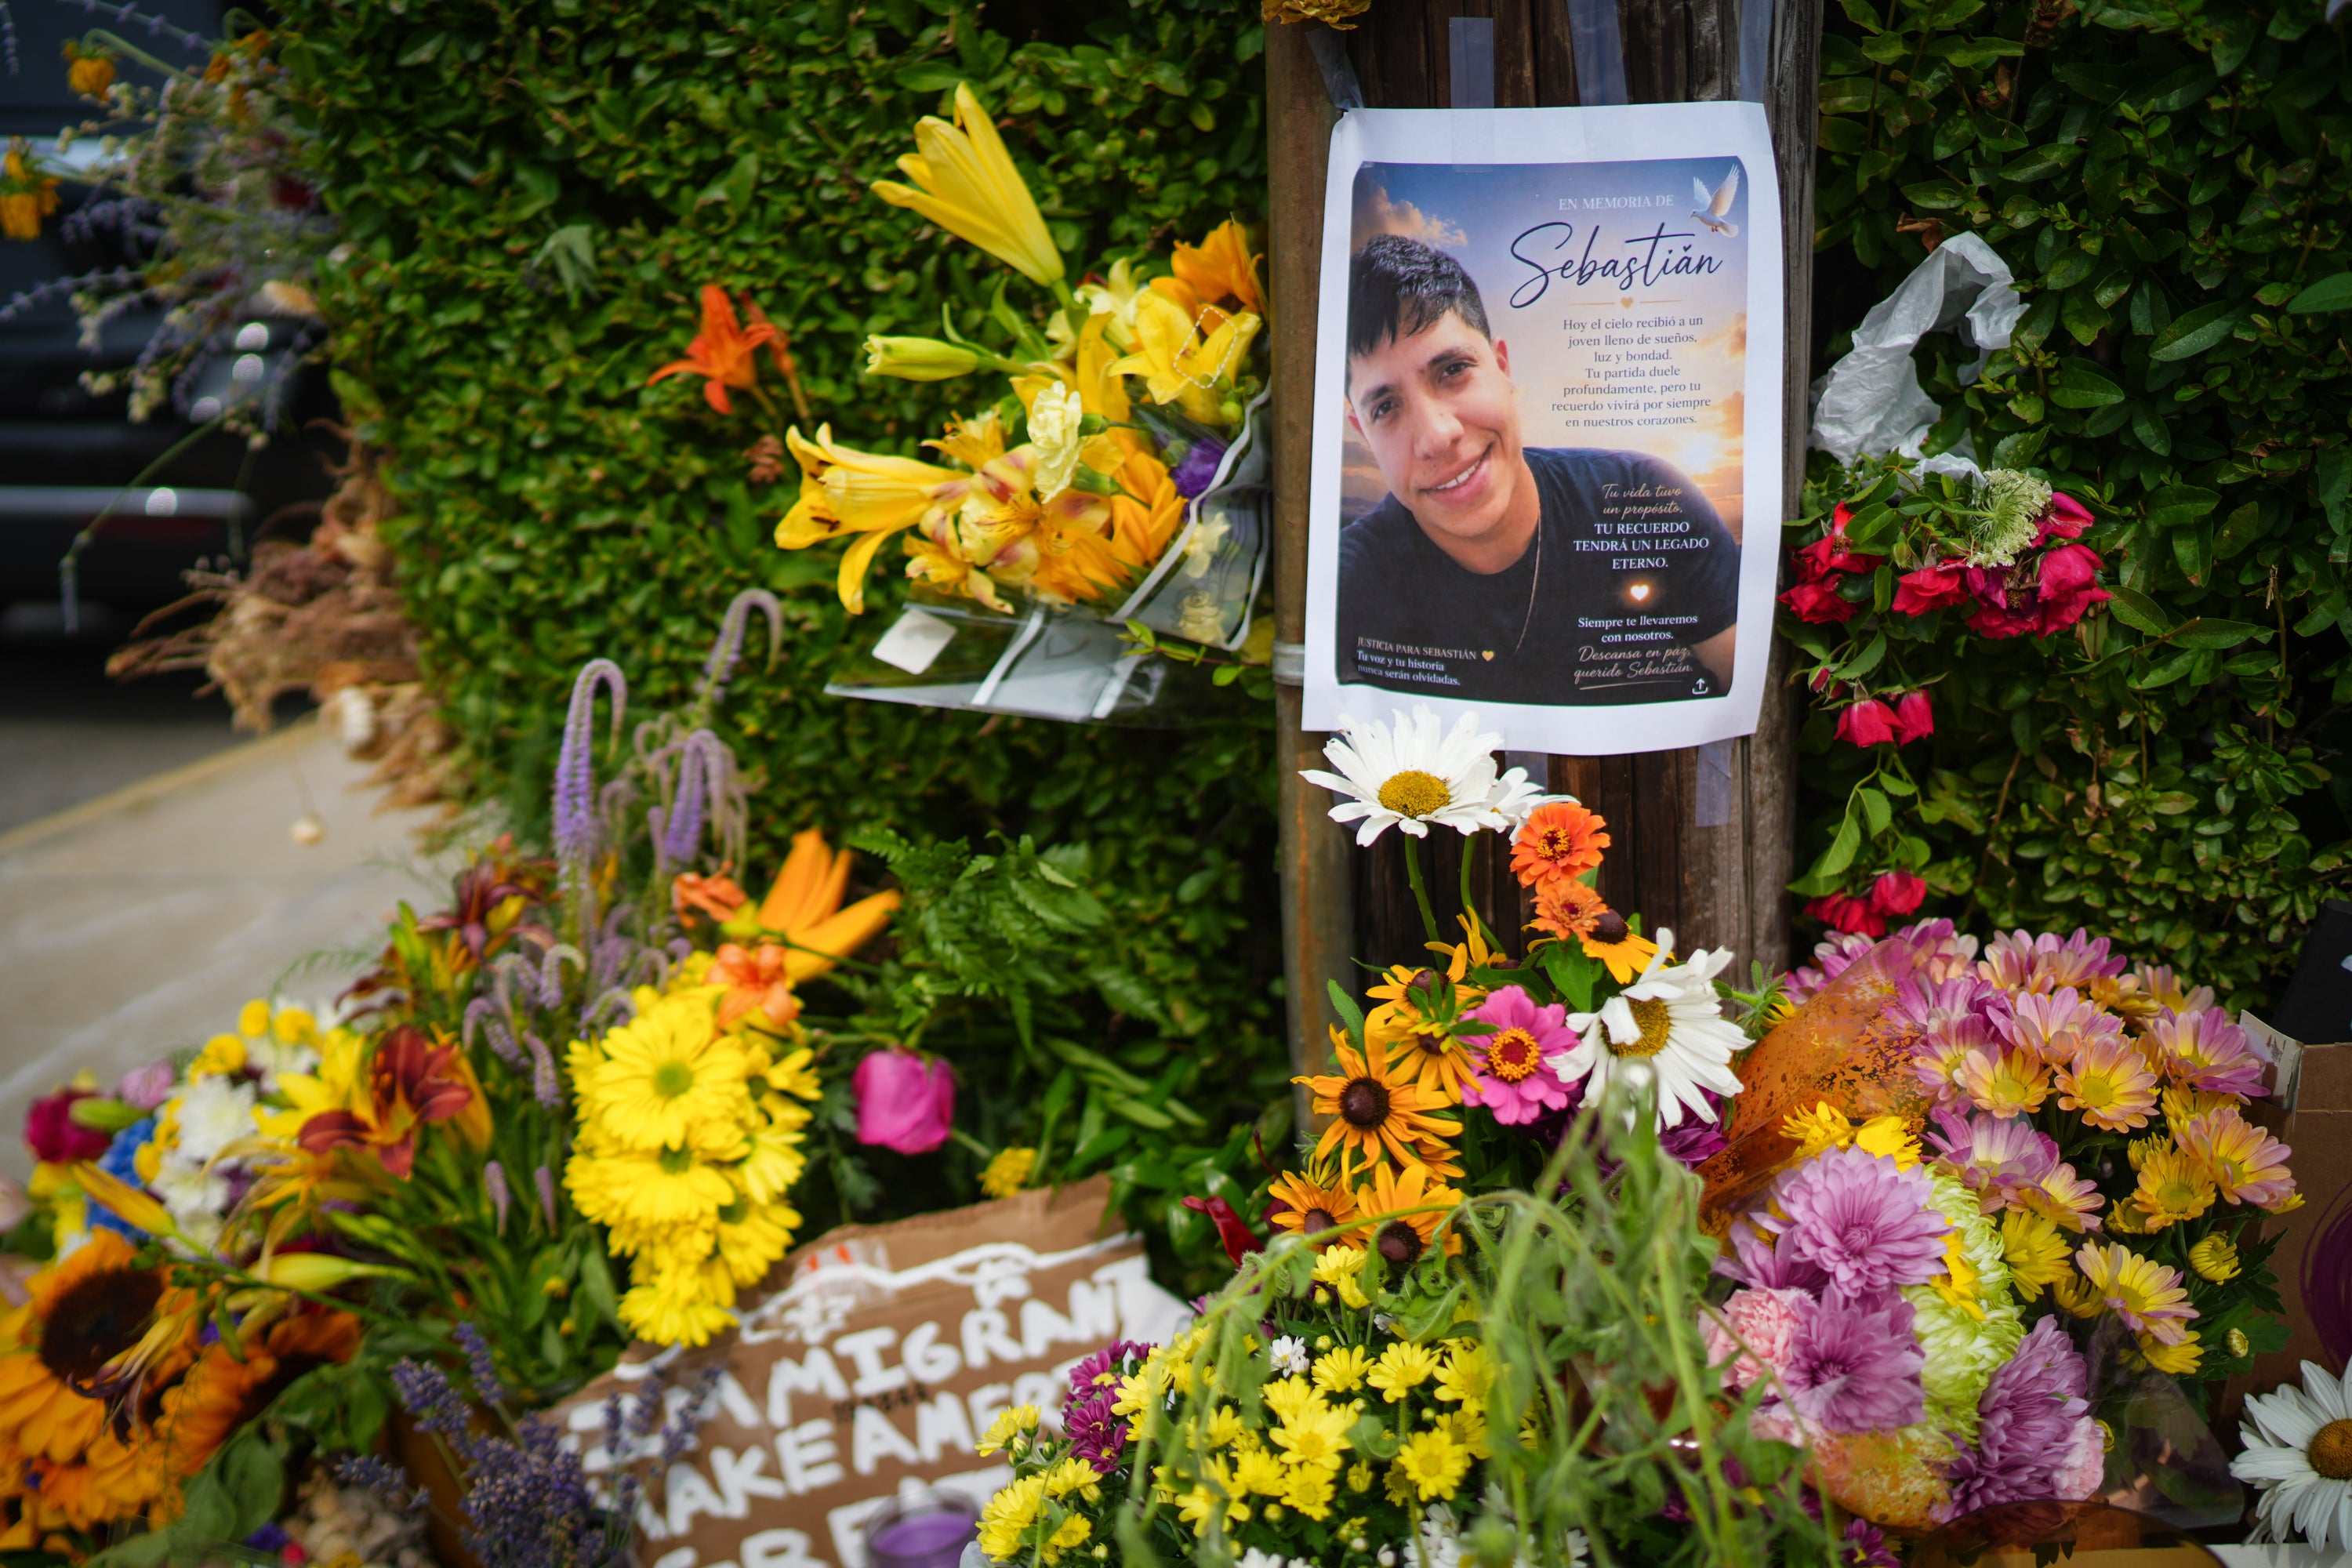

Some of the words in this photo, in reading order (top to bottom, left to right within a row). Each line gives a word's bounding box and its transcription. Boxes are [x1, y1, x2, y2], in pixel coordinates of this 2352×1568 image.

[1559, 198, 1577, 210] EN
[1582, 196, 1651, 210] MEMORIA
[1655, 194, 1674, 208] DE
[1563, 319, 1587, 332] Hoy
[1591, 318, 1601, 330] el
[1605, 318, 1632, 329] cielo
[1636, 316, 1675, 328] recibió
[1689, 317, 1704, 326] un
[1567, 336, 1600, 350] joven
[1604, 334, 1633, 347] lleno
[1637, 333, 1651, 345] de
[1594, 351, 1612, 363] luz
[1615, 354, 1623, 365] y
[1626, 349, 1672, 361] bondad.
[1585, 368, 1600, 379] Tu
[1604, 367, 1646, 381] partida
[1649, 365, 1681, 377] duele
[1661, 384, 1686, 395] pero
[1690, 382, 1701, 391] tu
[1552, 401, 1603, 412] recuerdo
[1607, 399, 1639, 411] vivirá
[1643, 401, 1663, 412] por
[1666, 397, 1711, 410] siempre
[1584, 416, 1633, 427] nuestros
[1637, 415, 1697, 426] corazones.
[1602, 483, 1620, 499] Tu
[1623, 483, 1652, 498] vida
[1655, 485, 1682, 498] tuvo
[1602, 506, 1621, 515] un
[1594, 523, 1613, 535] TU
[1617, 521, 1690, 535] RECUERDO
[1573, 538, 1628, 552] TENDRÁ
[1632, 539, 1652, 552] UN
[1655, 538, 1710, 550] LEGADO
[1611, 557, 1669, 570] ETERNO.
[1577, 617, 1624, 630] Siempre
[1626, 618, 1637, 626] te
[1639, 615, 1698, 626] llevaremos
[1601, 633, 1621, 643] con
[1624, 631, 1674, 642] nosotros.
[1357, 637, 1393, 652] JUSTICIA
[1396, 644, 1421, 655] PARA
[1422, 647, 1477, 660] SEBASTIÁN
[1577, 645, 1642, 662] Descansa
[1645, 648, 1662, 658] en
[1356, 650, 1368, 662] Tu
[1370, 655, 1385, 665] voz
[1387, 658, 1393, 667] y
[1396, 657, 1405, 668] tu
[1407, 658, 1445, 672] historia
[1357, 664, 1383, 677] nunca
[1385, 669, 1410, 681] serán
[1412, 671, 1461, 686] olvidadas.
[1573, 662, 1623, 685] querido
[1627, 661, 1693, 679] Sebastián.
